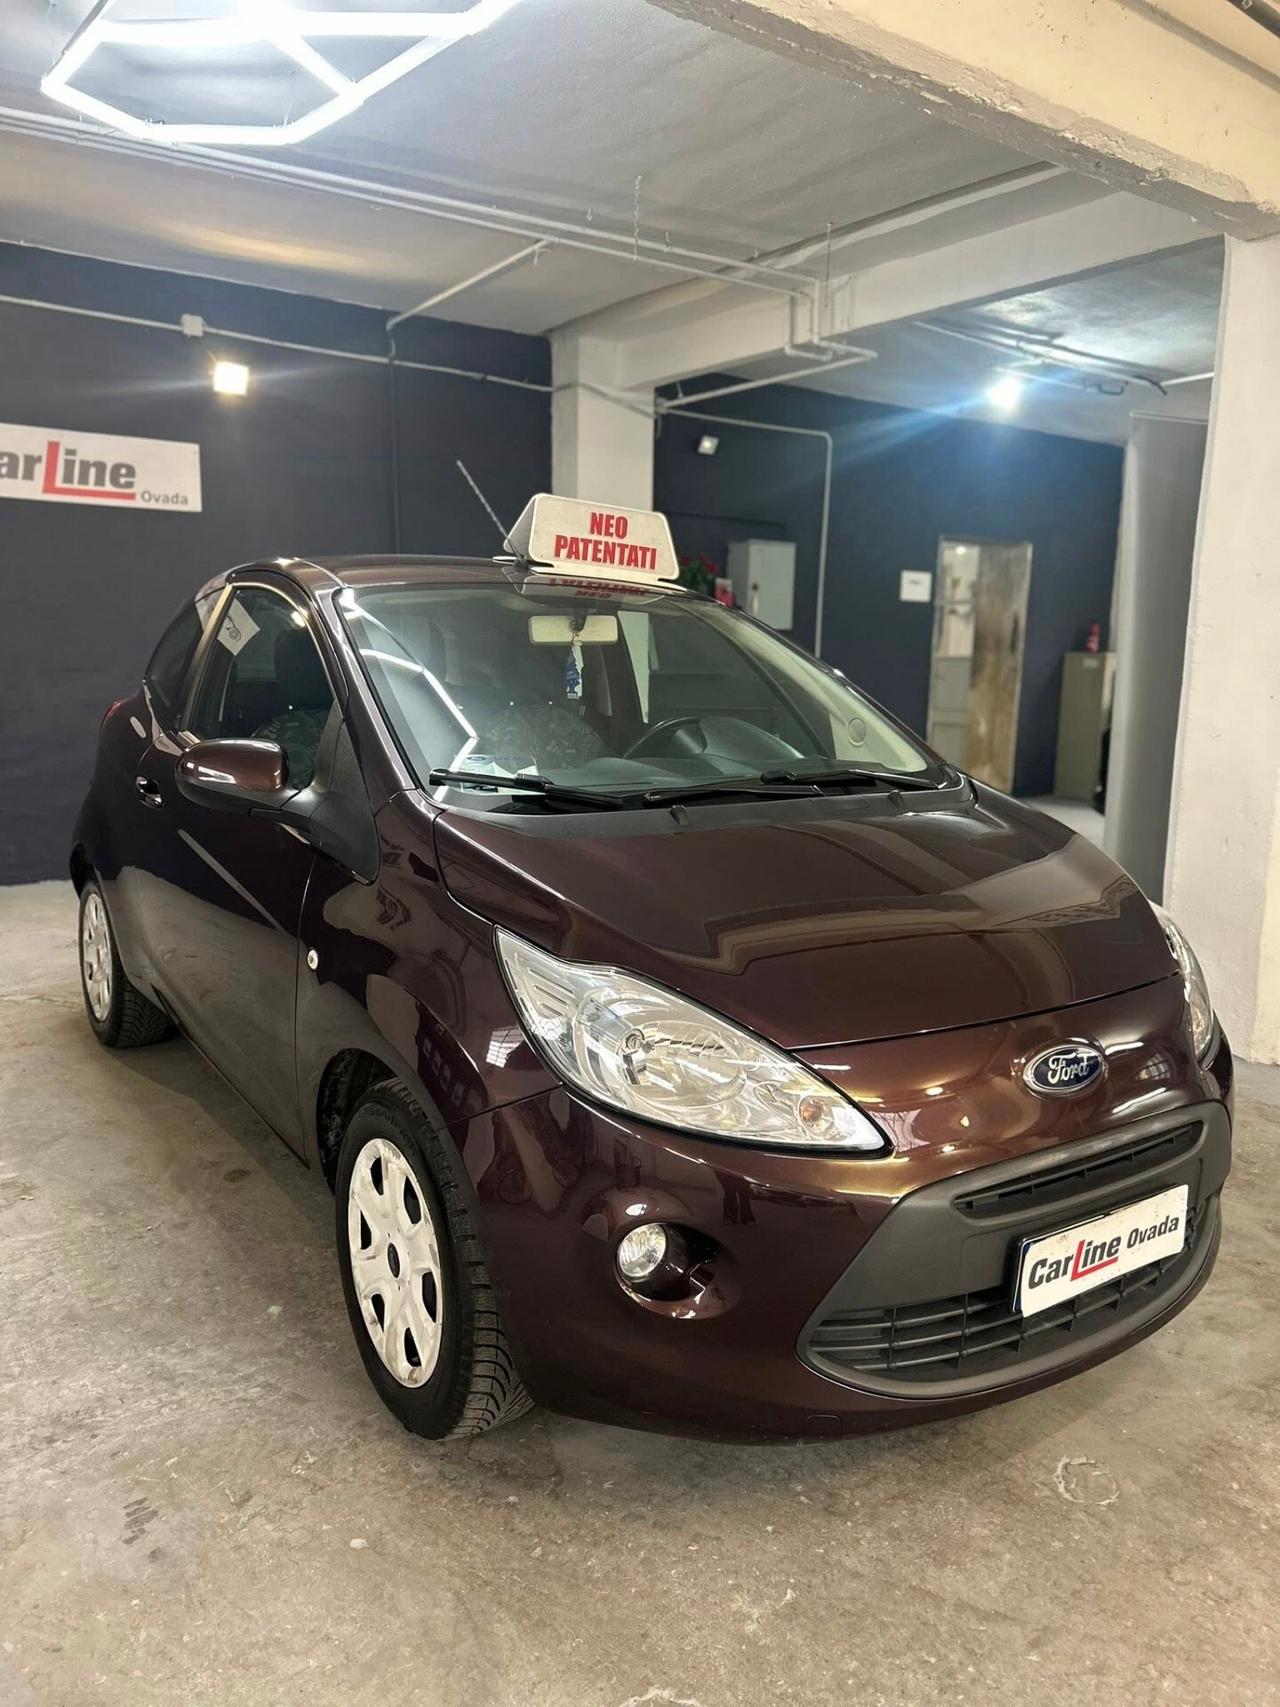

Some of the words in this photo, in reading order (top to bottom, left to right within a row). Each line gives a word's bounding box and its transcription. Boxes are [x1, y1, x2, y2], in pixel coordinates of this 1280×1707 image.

[0, 440, 136, 500] arLine
[140, 490, 189, 506] Ovada
[590, 512, 628, 539] NEO
[554, 534, 657, 570] PATENTATI
[1048, 1052, 1090, 1084] Ford
[1028, 1239, 1122, 1290] CarLine
[1126, 1215, 1180, 1250] Ovada
